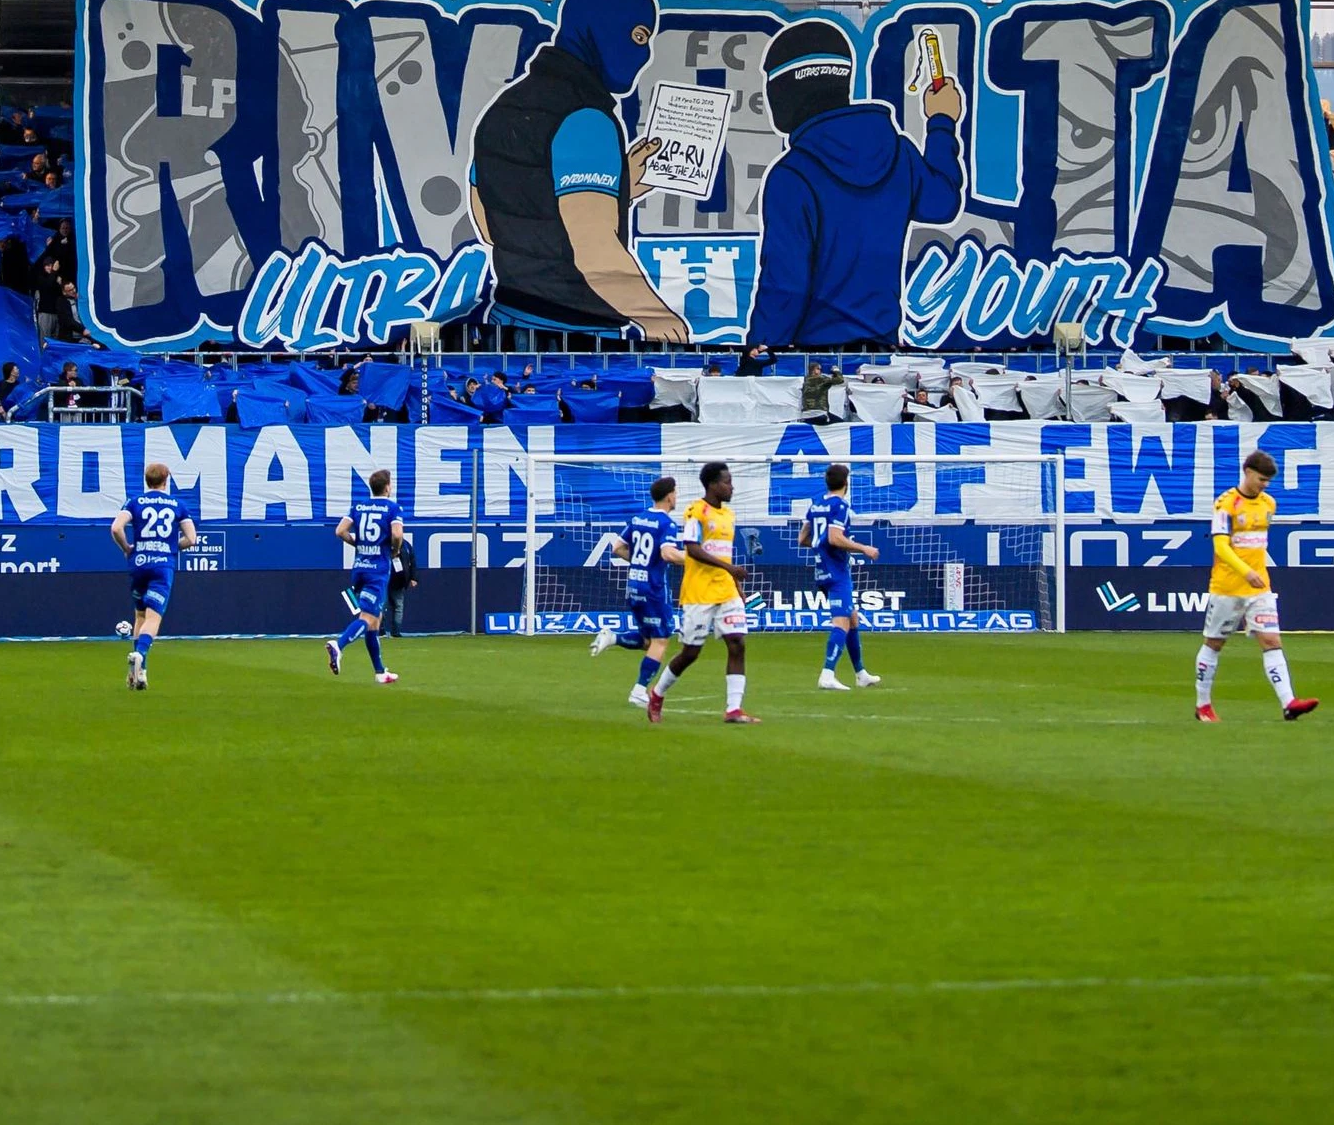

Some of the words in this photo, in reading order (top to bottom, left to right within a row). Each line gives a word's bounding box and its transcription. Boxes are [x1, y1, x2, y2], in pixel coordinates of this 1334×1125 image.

[182, 75, 236, 118] LP
[240, 245, 491, 350] ULTRA
[903, 243, 1162, 349] YOUTH
[769, 423, 991, 516] AUF
[1041, 423, 1320, 516] EWIG
[137, 496, 178, 507] Oberbank
[141, 506, 175, 538] 23
[359, 513, 382, 542] 15
[196, 536, 208, 544] FC
[631, 530, 655, 567] 29
[489, 614, 561, 630] LINZ
[572, 614, 621, 629] AG
[903, 612, 976, 628] LINZ
[986, 613, 1032, 628] AG
